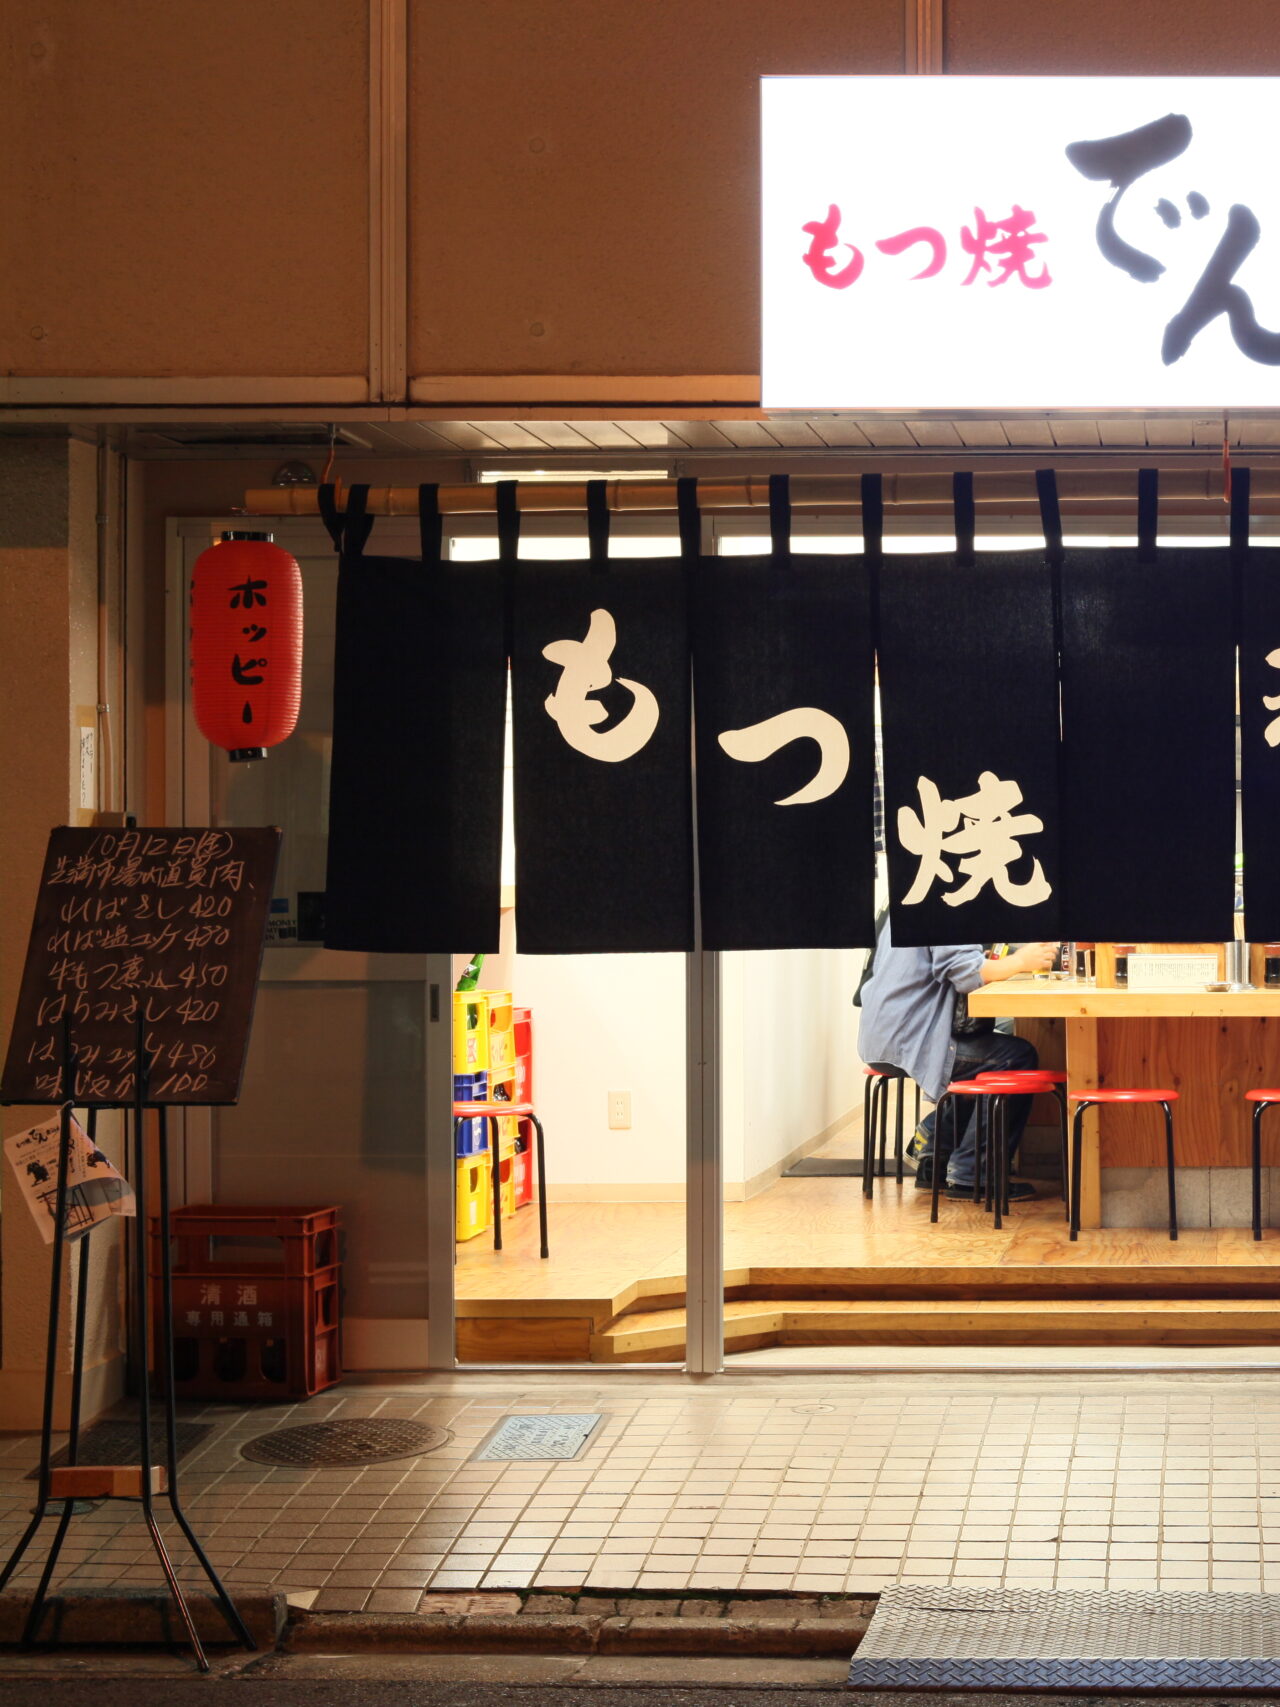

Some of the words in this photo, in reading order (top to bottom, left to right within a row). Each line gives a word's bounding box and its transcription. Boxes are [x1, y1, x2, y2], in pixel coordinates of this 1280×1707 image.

[801, 203, 1052, 290] もつ焼
[228, 576, 268, 724] ホッピー
[542, 609, 1053, 907] もつ焼
[188, 895, 232, 919] 420
[184, 926, 230, 951] 480
[178, 962, 228, 989] 450
[175, 997, 220, 1024] 420
[200, 1283, 258, 1305] 清酒
